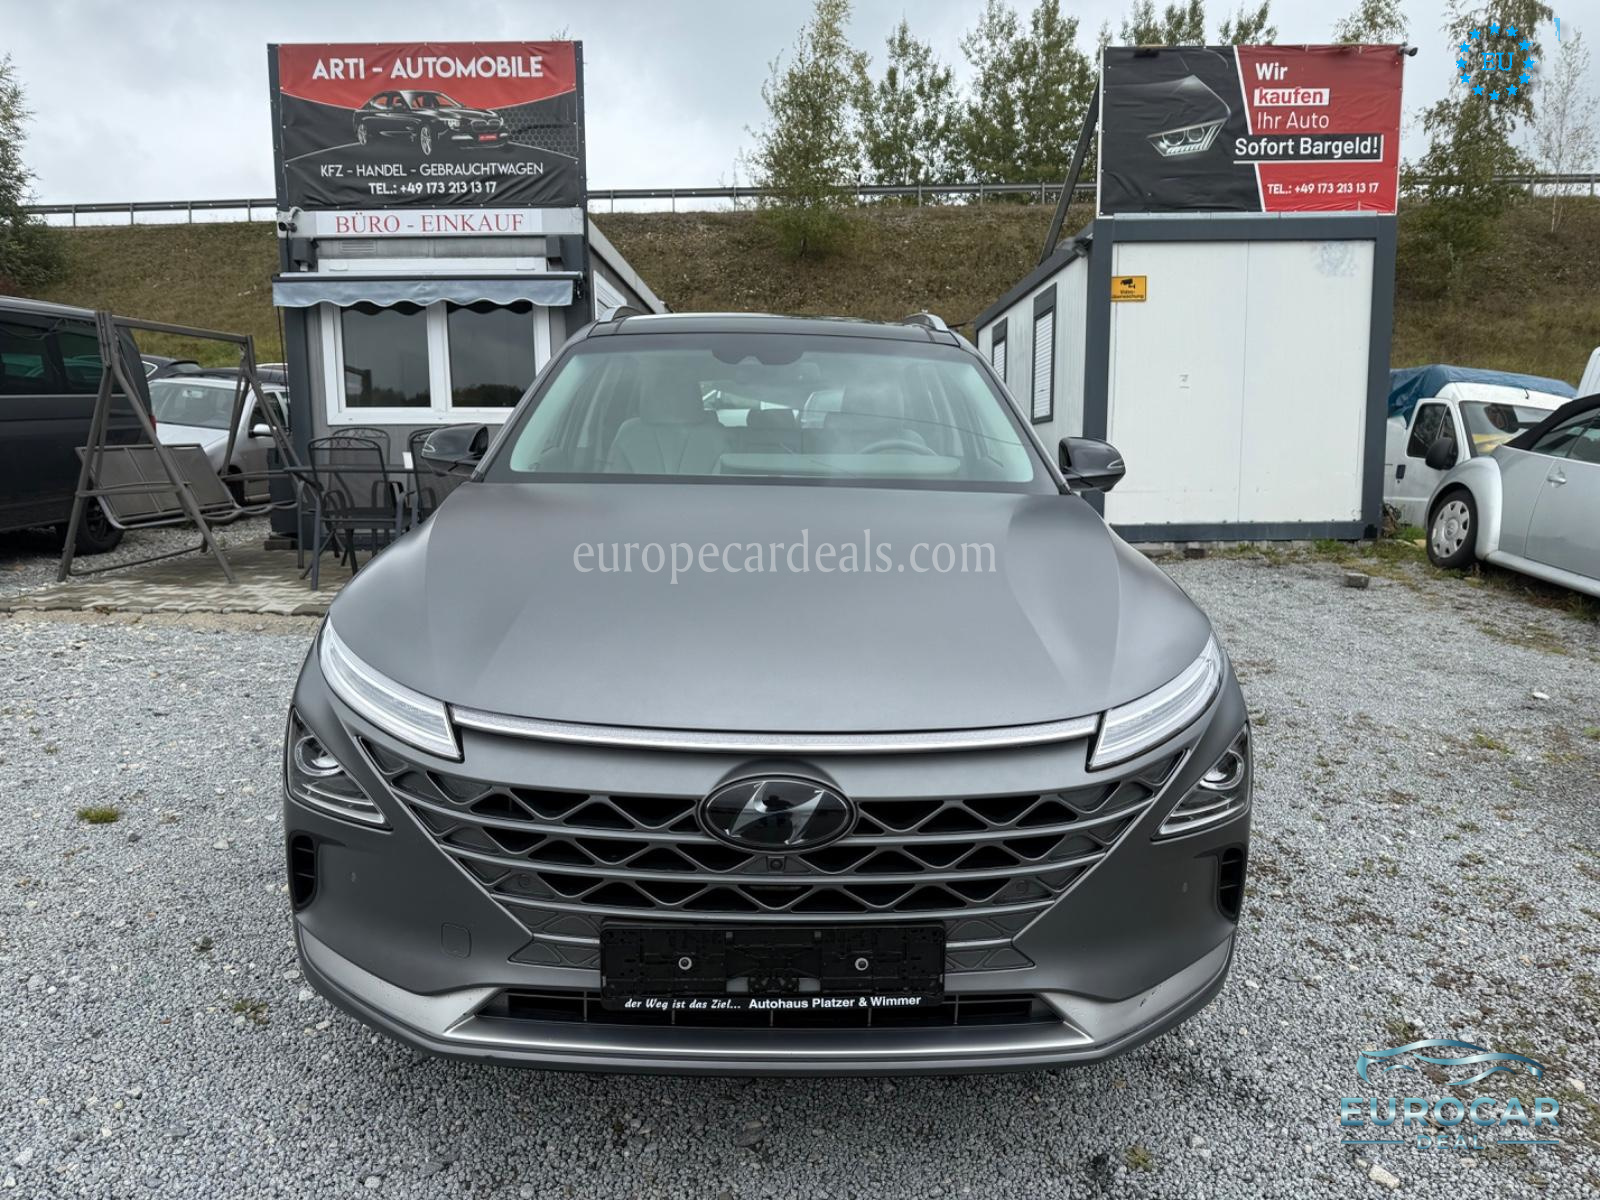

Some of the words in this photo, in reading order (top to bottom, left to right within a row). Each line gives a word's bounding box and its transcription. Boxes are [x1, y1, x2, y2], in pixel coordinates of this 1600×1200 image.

[312, 58, 365, 80] ARTI
[390, 56, 544, 79] AUTOMOBILE
[1255, 63, 1288, 80] Wir
[1257, 87, 1324, 104] kaufen
[1257, 112, 1282, 129] Ihr
[1286, 111, 1330, 129] Auto
[1235, 138, 1295, 155] Sofort
[1300, 136, 1378, 158] Bargeld!
[320, 164, 344, 177] KFZ
[356, 163, 407, 177] HANDEL
[419, 162, 543, 176] GEBRAUCHTWAGEN
[368, 182, 397, 194] TEL.:
[400, 182, 423, 193] +49
[427, 182, 445, 193] 173
[449, 181, 467, 193] 213
[471, 181, 482, 193] 13
[485, 181, 497, 193] 17
[1267, 183, 1292, 194] TEL.:
[1295, 183, 1314, 193] +49
[1318, 183, 1334, 193] 173
[1337, 182, 1353, 193] 213
[1356, 182, 1366, 193] 13
[1369, 182, 1379, 192] 17
[335, 212, 400, 233] BÜRO
[421, 213, 524, 232] EINKAUF
[624, 998, 642, 1008] der
[645, 998, 668, 1011] Weg
[672, 998, 686, 1008] ist
[689, 999, 708, 1009] das
[710, 999, 741, 1009] Ziel...
[749, 999, 808, 1009] Autohaus
[812, 998, 855, 1008] Platzer
[858, 997, 867, 1007] &
[870, 996, 921, 1007] Wimmer
